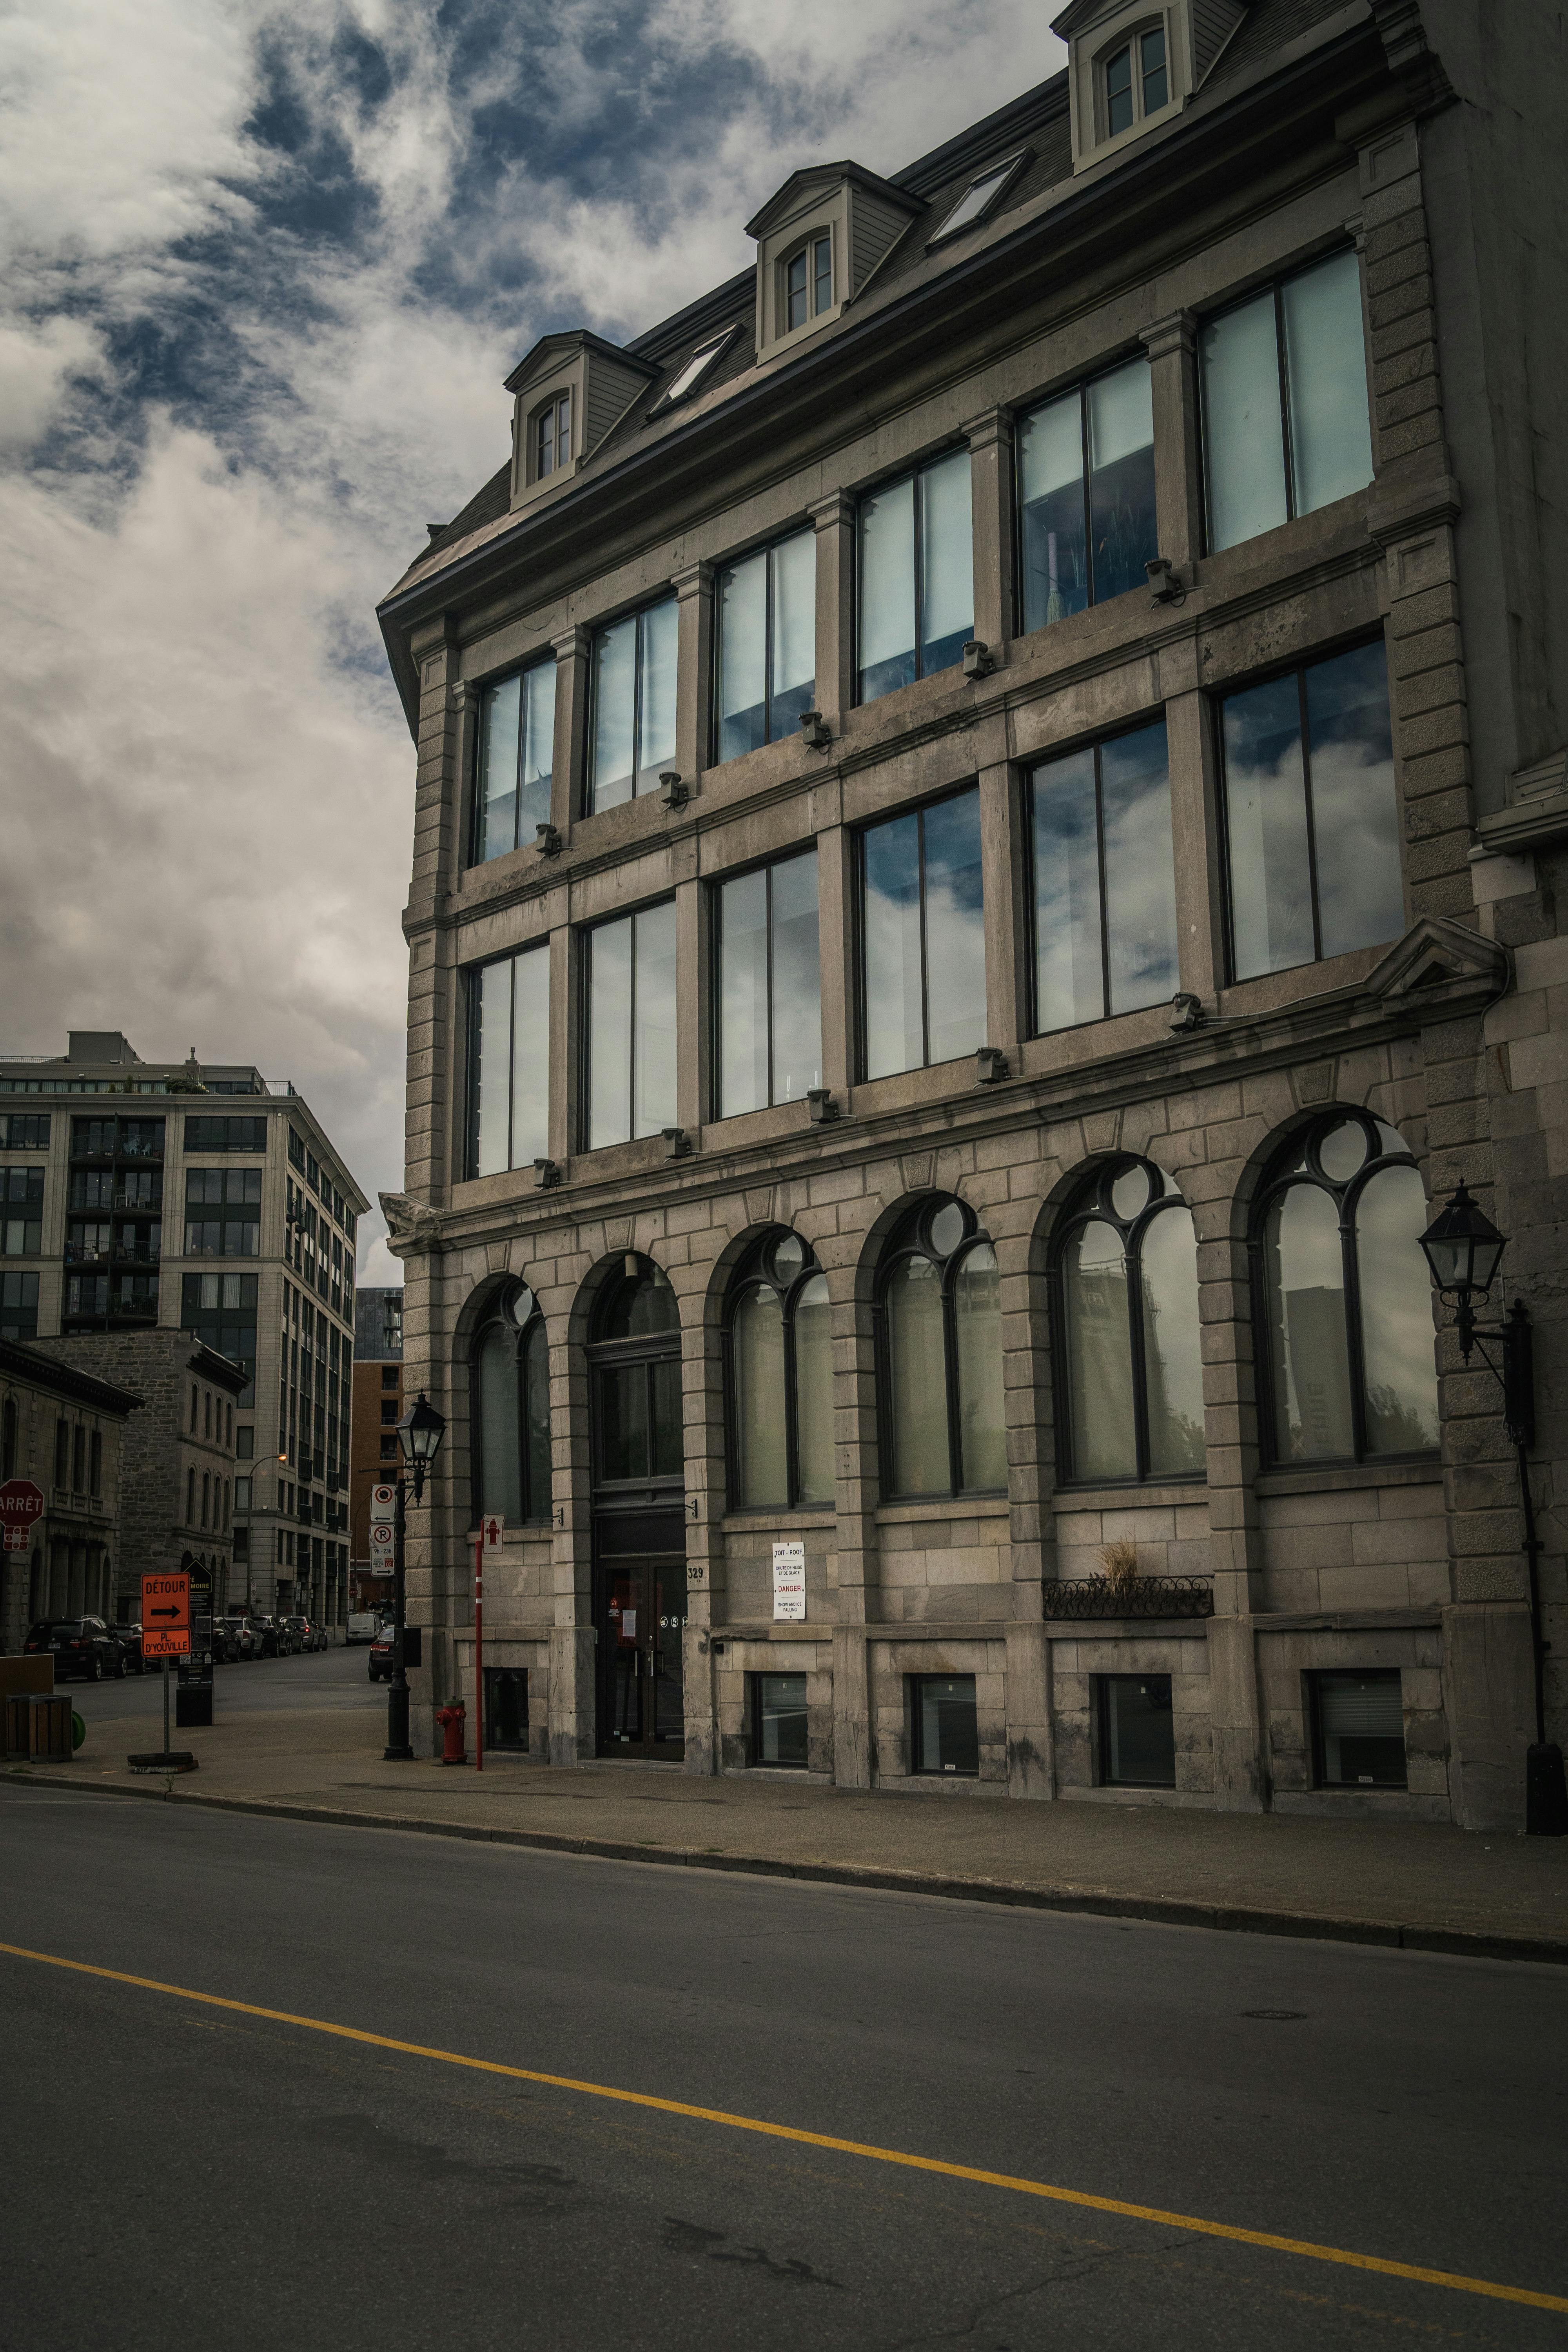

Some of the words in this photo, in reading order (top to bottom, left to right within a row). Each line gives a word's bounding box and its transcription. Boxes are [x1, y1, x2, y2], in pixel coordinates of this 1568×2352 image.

[0, 1496, 41, 1512] ARRÊT
[688, 1568, 703, 1579] 329
[146, 1579, 185, 1594] DÉTOUR
[161, 1633, 171, 1642] PL.
[146, 1641, 187, 1653] D'YOUVILLE
